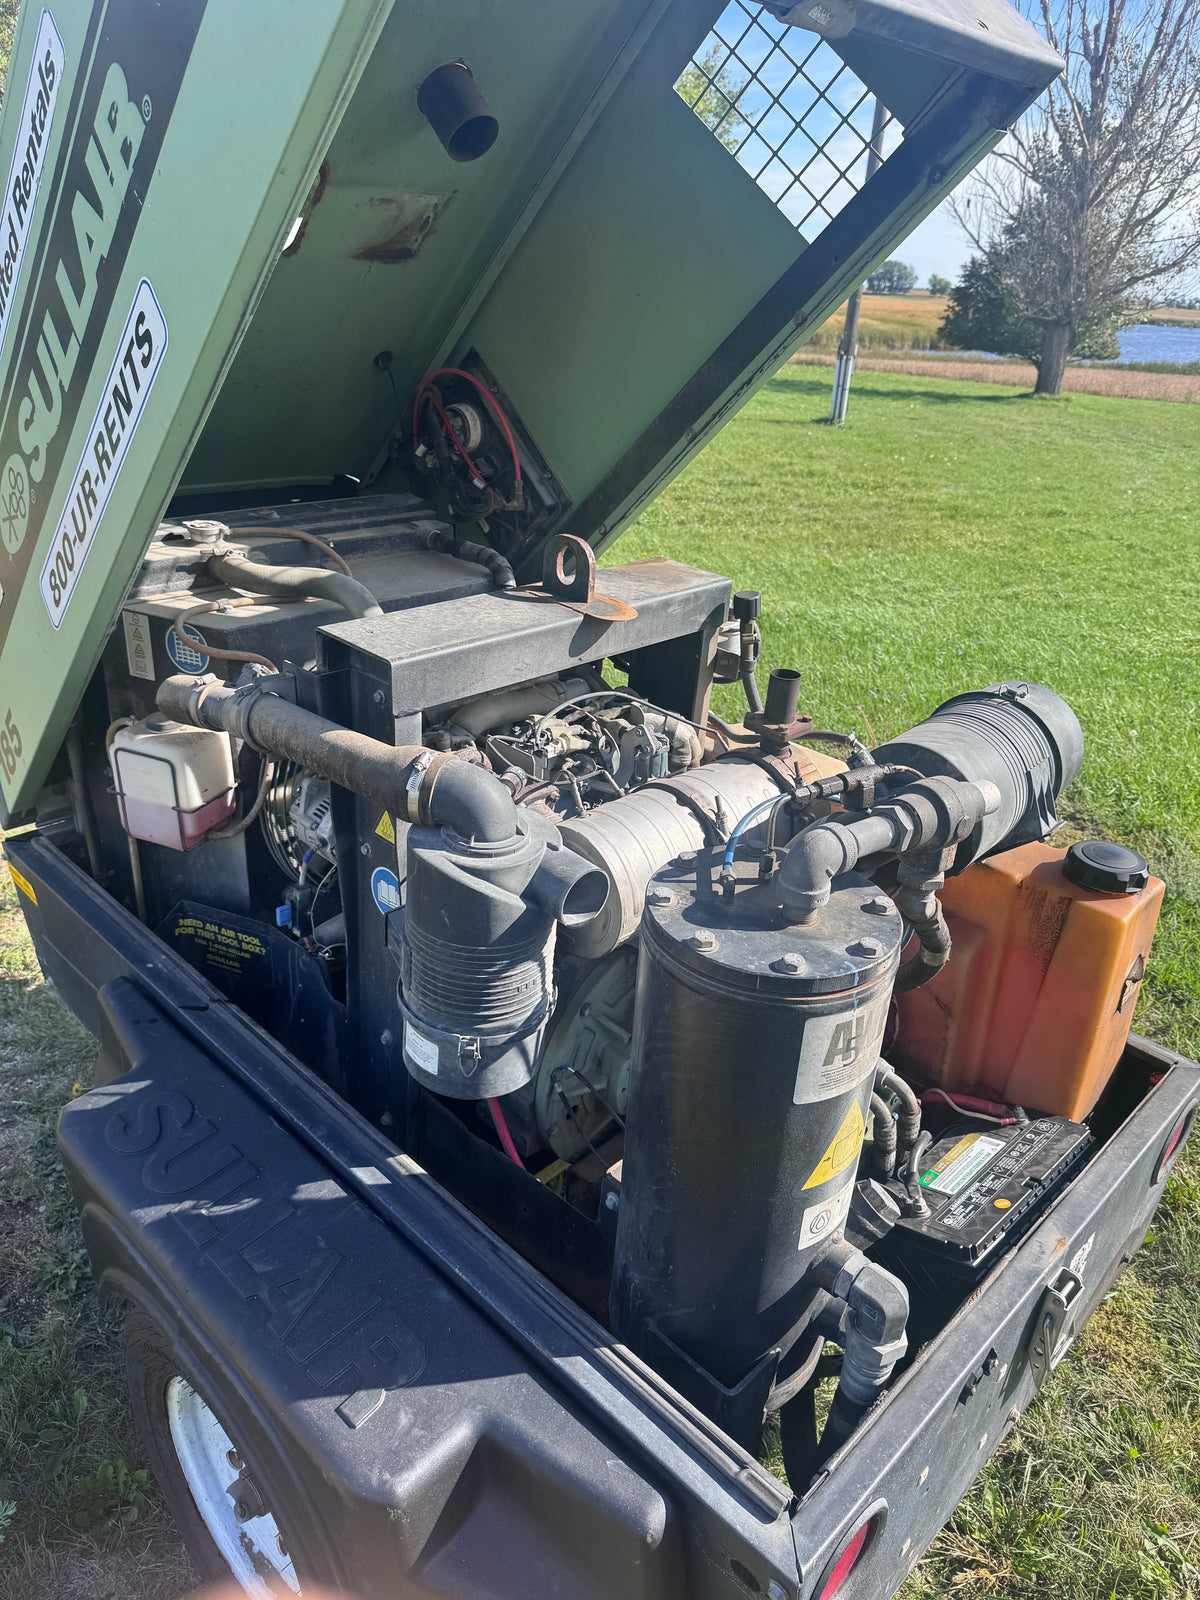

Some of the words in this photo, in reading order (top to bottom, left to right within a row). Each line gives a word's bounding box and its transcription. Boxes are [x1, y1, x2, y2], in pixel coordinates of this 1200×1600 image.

[13, 49, 56, 231] Rentals
[18, 62, 147, 483] SULLAIR
[49, 311, 154, 608] 800-UR-RENTS
[174, 926, 196, 937] FOR
[196, 928, 215, 940] THIS
[217, 934, 241, 948] TOOL
[241, 942, 266, 956] BOX?
[179, 919, 203, 929] NEED
[205, 923, 219, 934] AN
[221, 927, 236, 939] AIR
[237, 932, 262, 946] TOOL
[104, 1090, 428, 1431] SULLAIR
